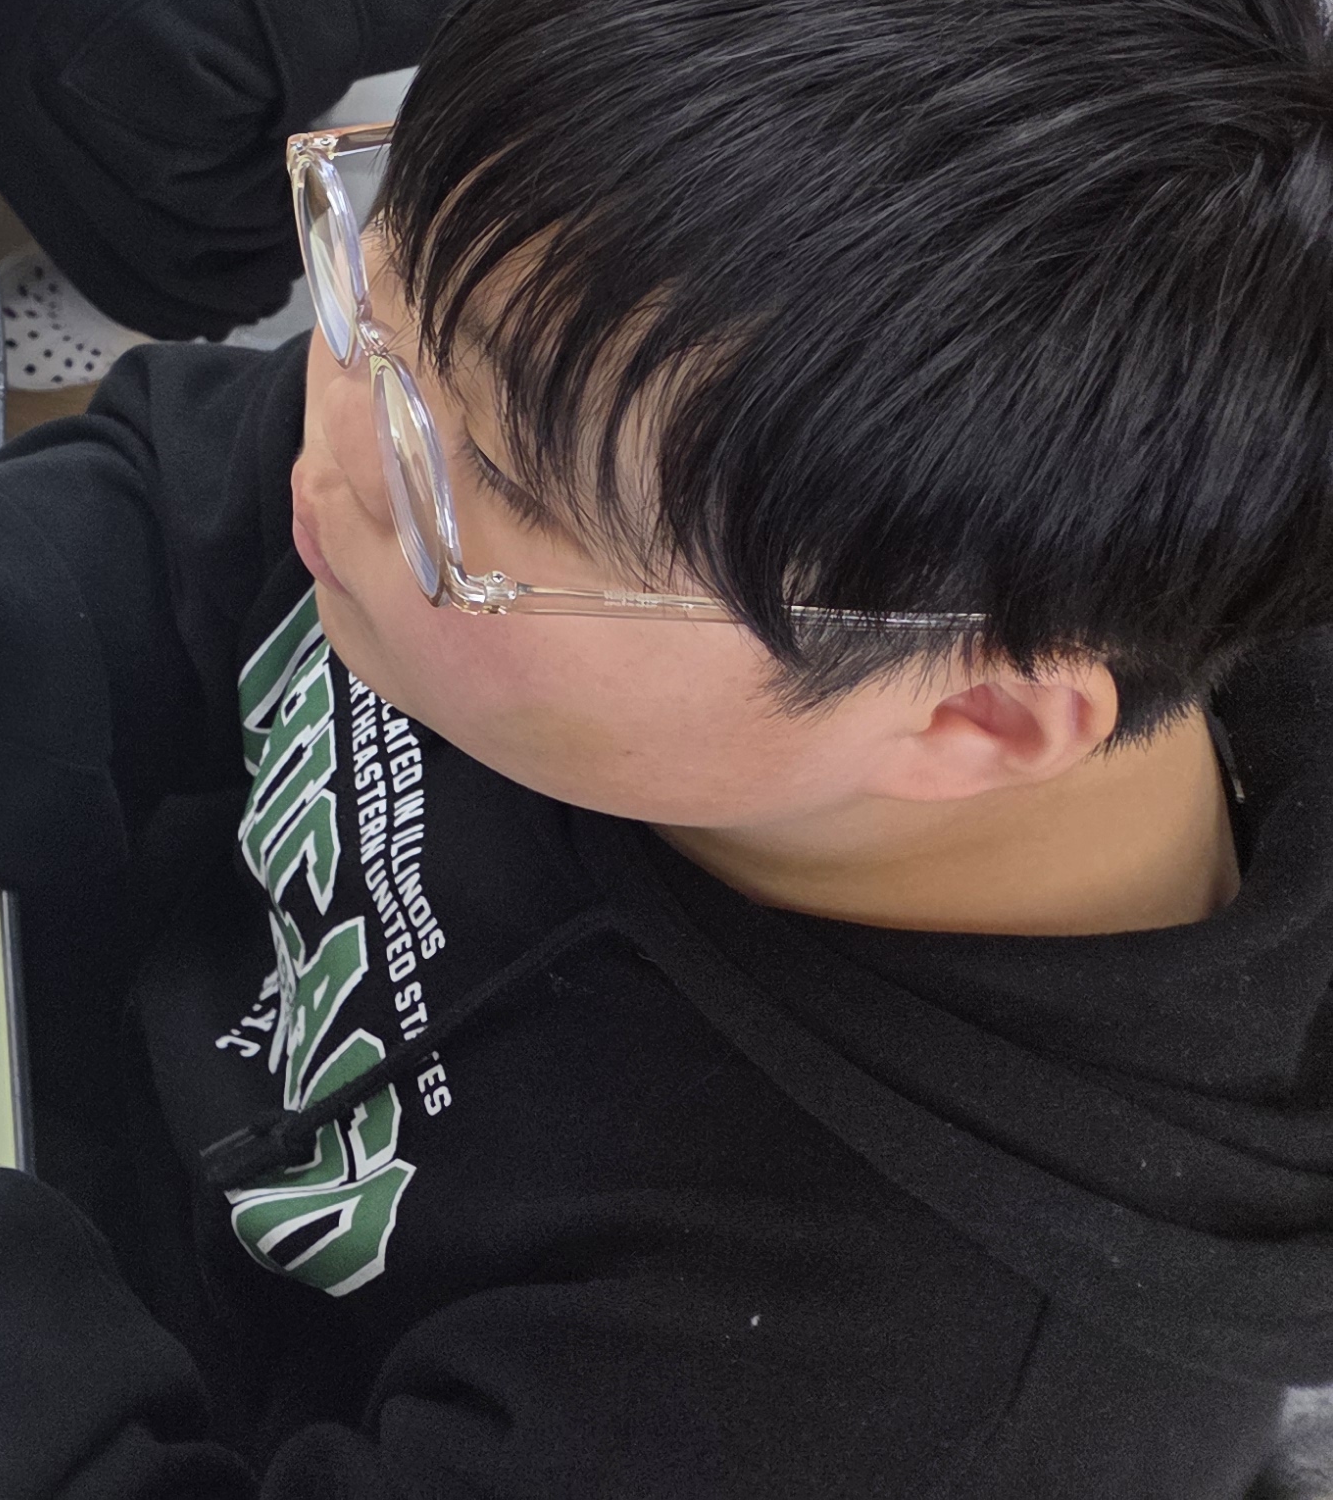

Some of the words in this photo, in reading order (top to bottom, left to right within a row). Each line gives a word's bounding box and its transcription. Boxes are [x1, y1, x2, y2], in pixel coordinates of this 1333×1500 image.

[348, 671, 388, 867] RTHEASTERN
[380, 697, 424, 793] CATED
[393, 788, 425, 828] IN
[363, 857, 417, 984] UNITED
[390, 823, 446, 960] ILLINOIS
[393, 980, 453, 1117] STES
